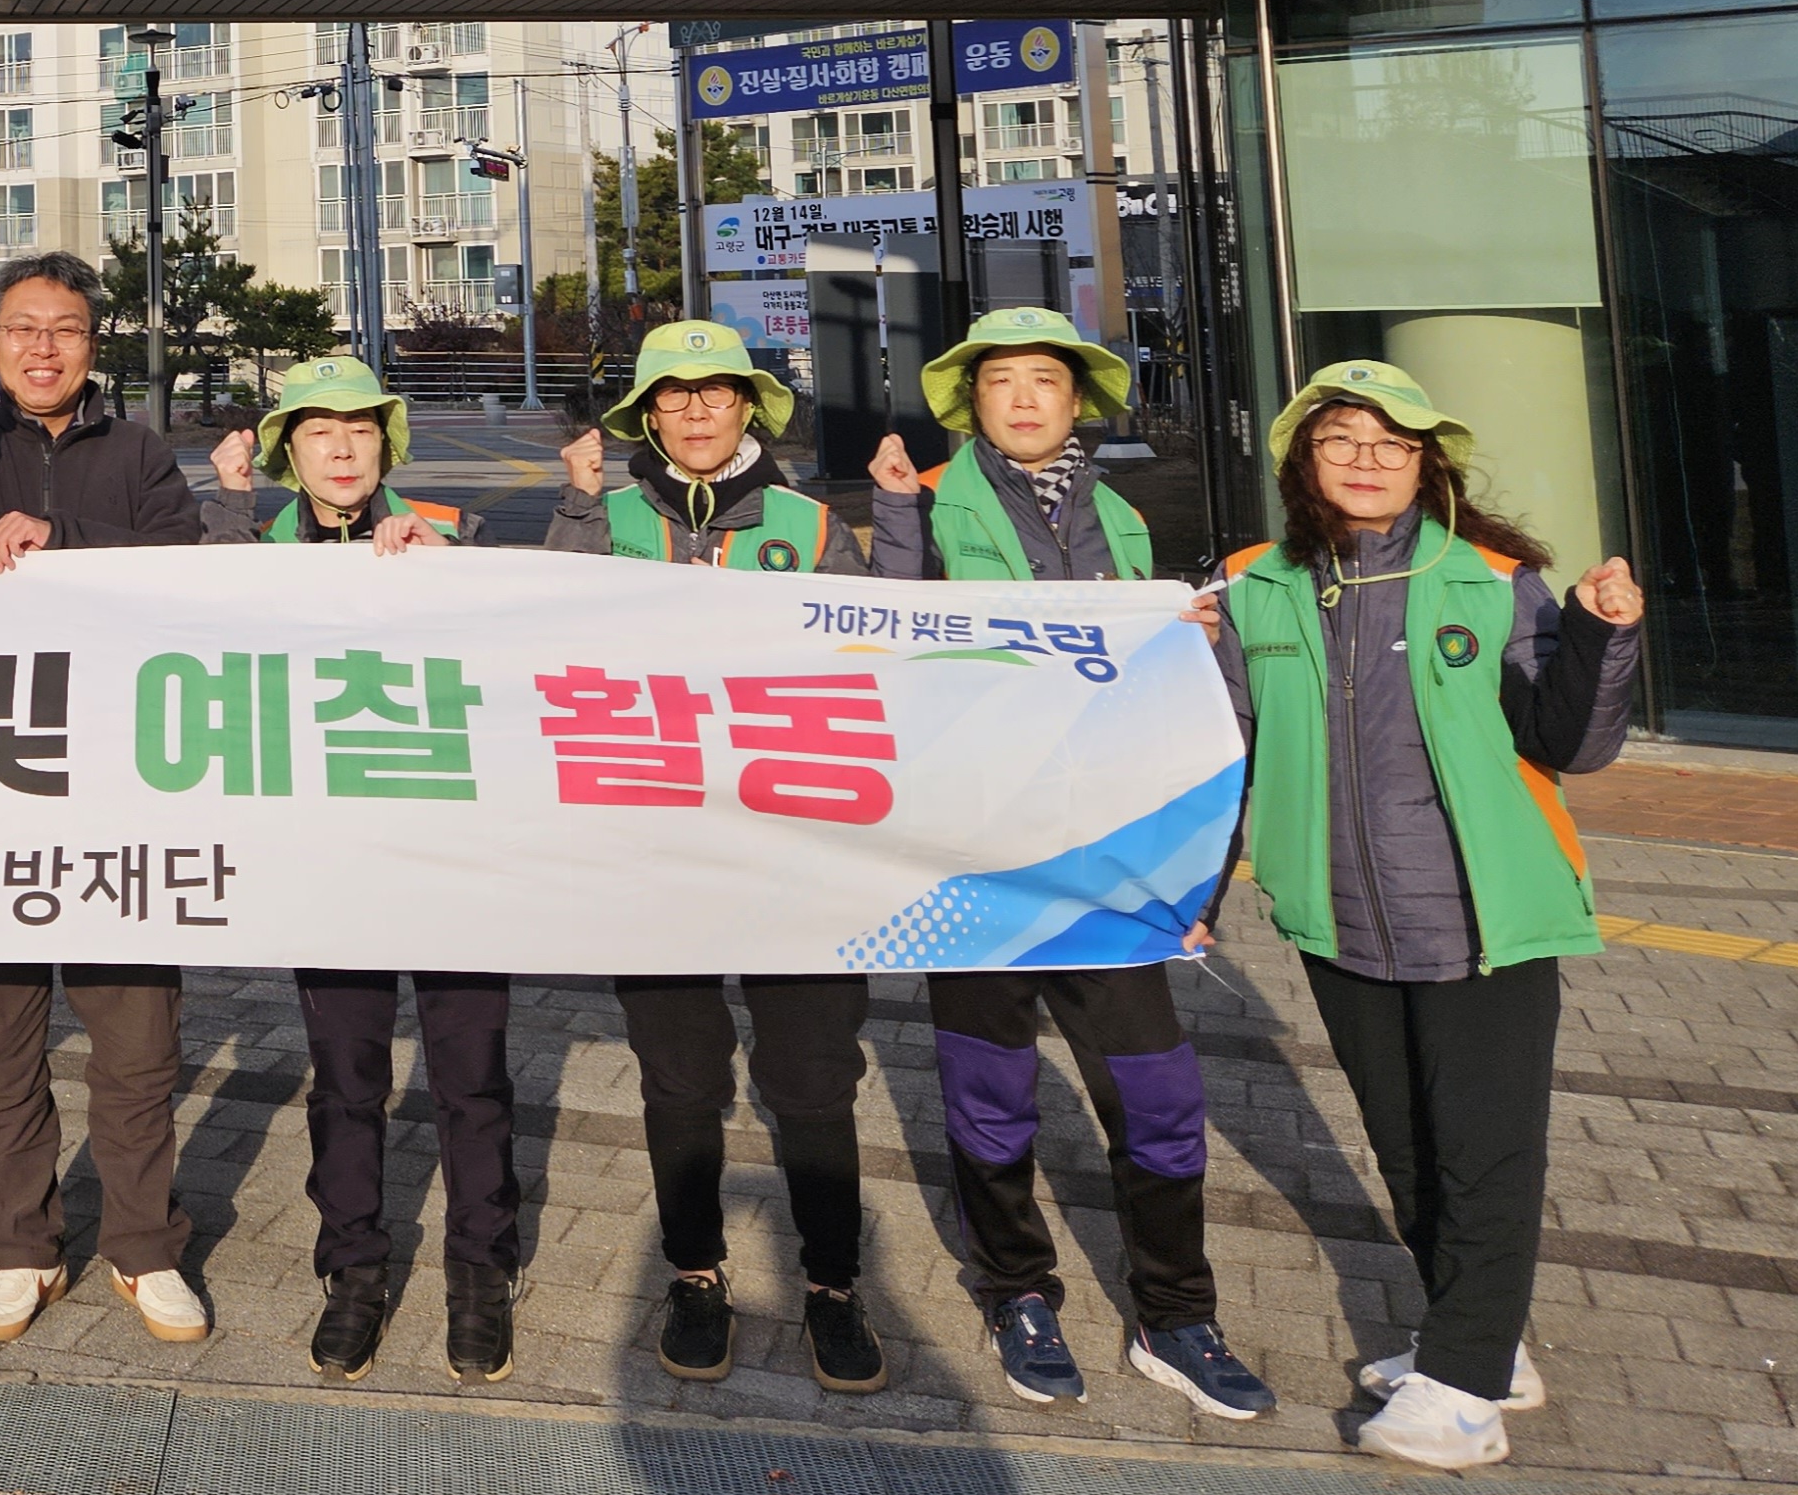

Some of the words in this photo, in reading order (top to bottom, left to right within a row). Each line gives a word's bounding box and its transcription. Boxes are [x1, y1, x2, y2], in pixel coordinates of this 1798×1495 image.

[801, 45, 831, 59] 국민과
[965, 41, 1012, 71] 운동
[753, 206, 784, 222] 12월
[790, 204, 827, 221] 14일,
[1025, 208, 1064, 238] 시행
[715, 241, 745, 253] 고령군
[802, 602, 901, 642] 가야가
[910, 609, 974, 643] 빚은
[987, 617, 1121, 684] 고령
[134, 649, 484, 801] 예찰
[534, 665, 899, 826] 활동
